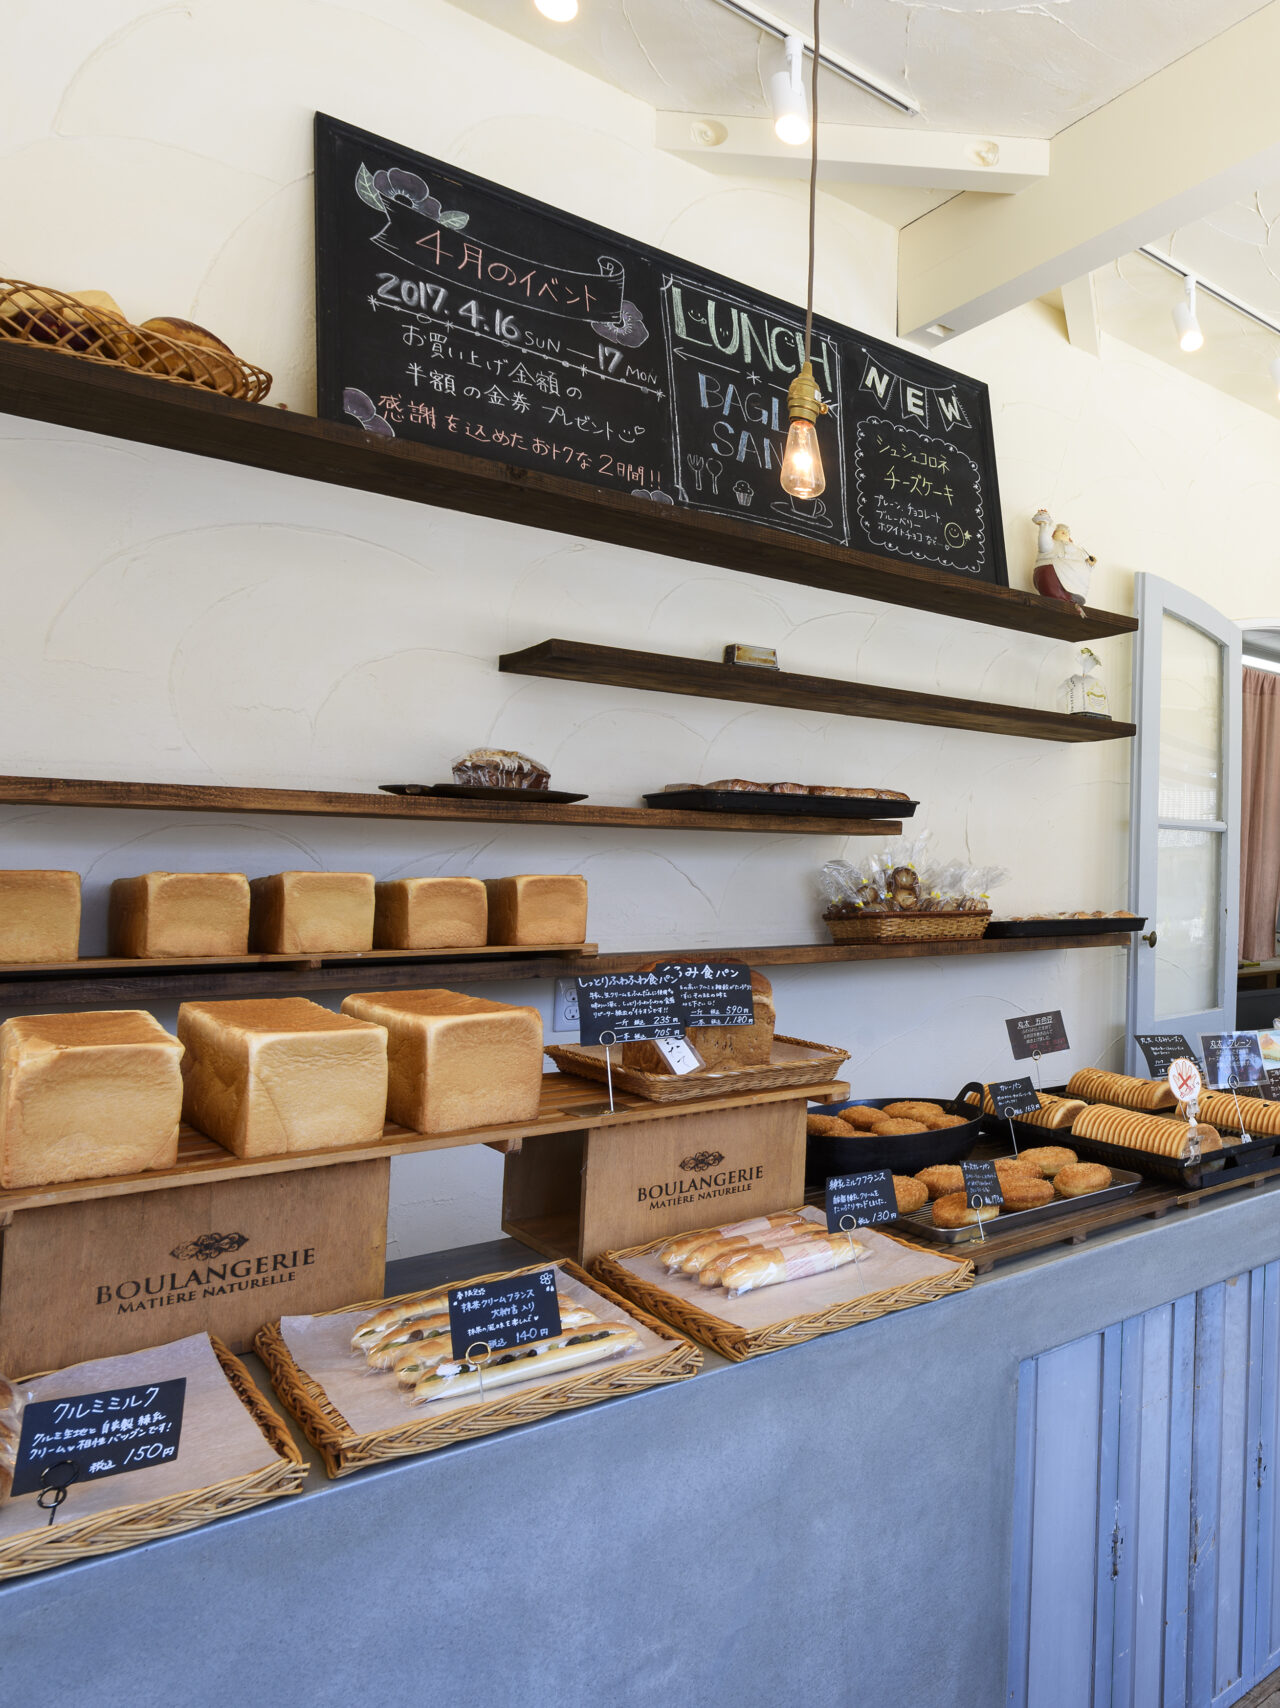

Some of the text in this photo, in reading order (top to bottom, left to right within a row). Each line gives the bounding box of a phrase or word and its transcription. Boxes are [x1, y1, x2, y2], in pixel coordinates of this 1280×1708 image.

[416, 229, 598, 312] 4月のイベント
[525, 330, 560, 353] SUN
[599, 342, 624, 373] 17
[625, 365, 658, 385] MON
[671, 286, 833, 392] LUNCH
[401, 324, 582, 399] お買い上げ金額の
[866, 367, 963, 422] NEW
[884, 465, 954, 506] チーズケーキ
[578, 973, 679, 988] しっとりふわふわ食パン
[637, 1165, 764, 1202] BOULANGERIE
[649, 1182, 752, 1211] MATIÈRE NATURELLE
[96, 1248, 315, 1305] BOULANGERIE
[117, 1272, 296, 1315] MATIÈRE NATURELLE
[53, 1387, 159, 1424] クルミミルク
[123, 1443, 175, 1465] 150円
